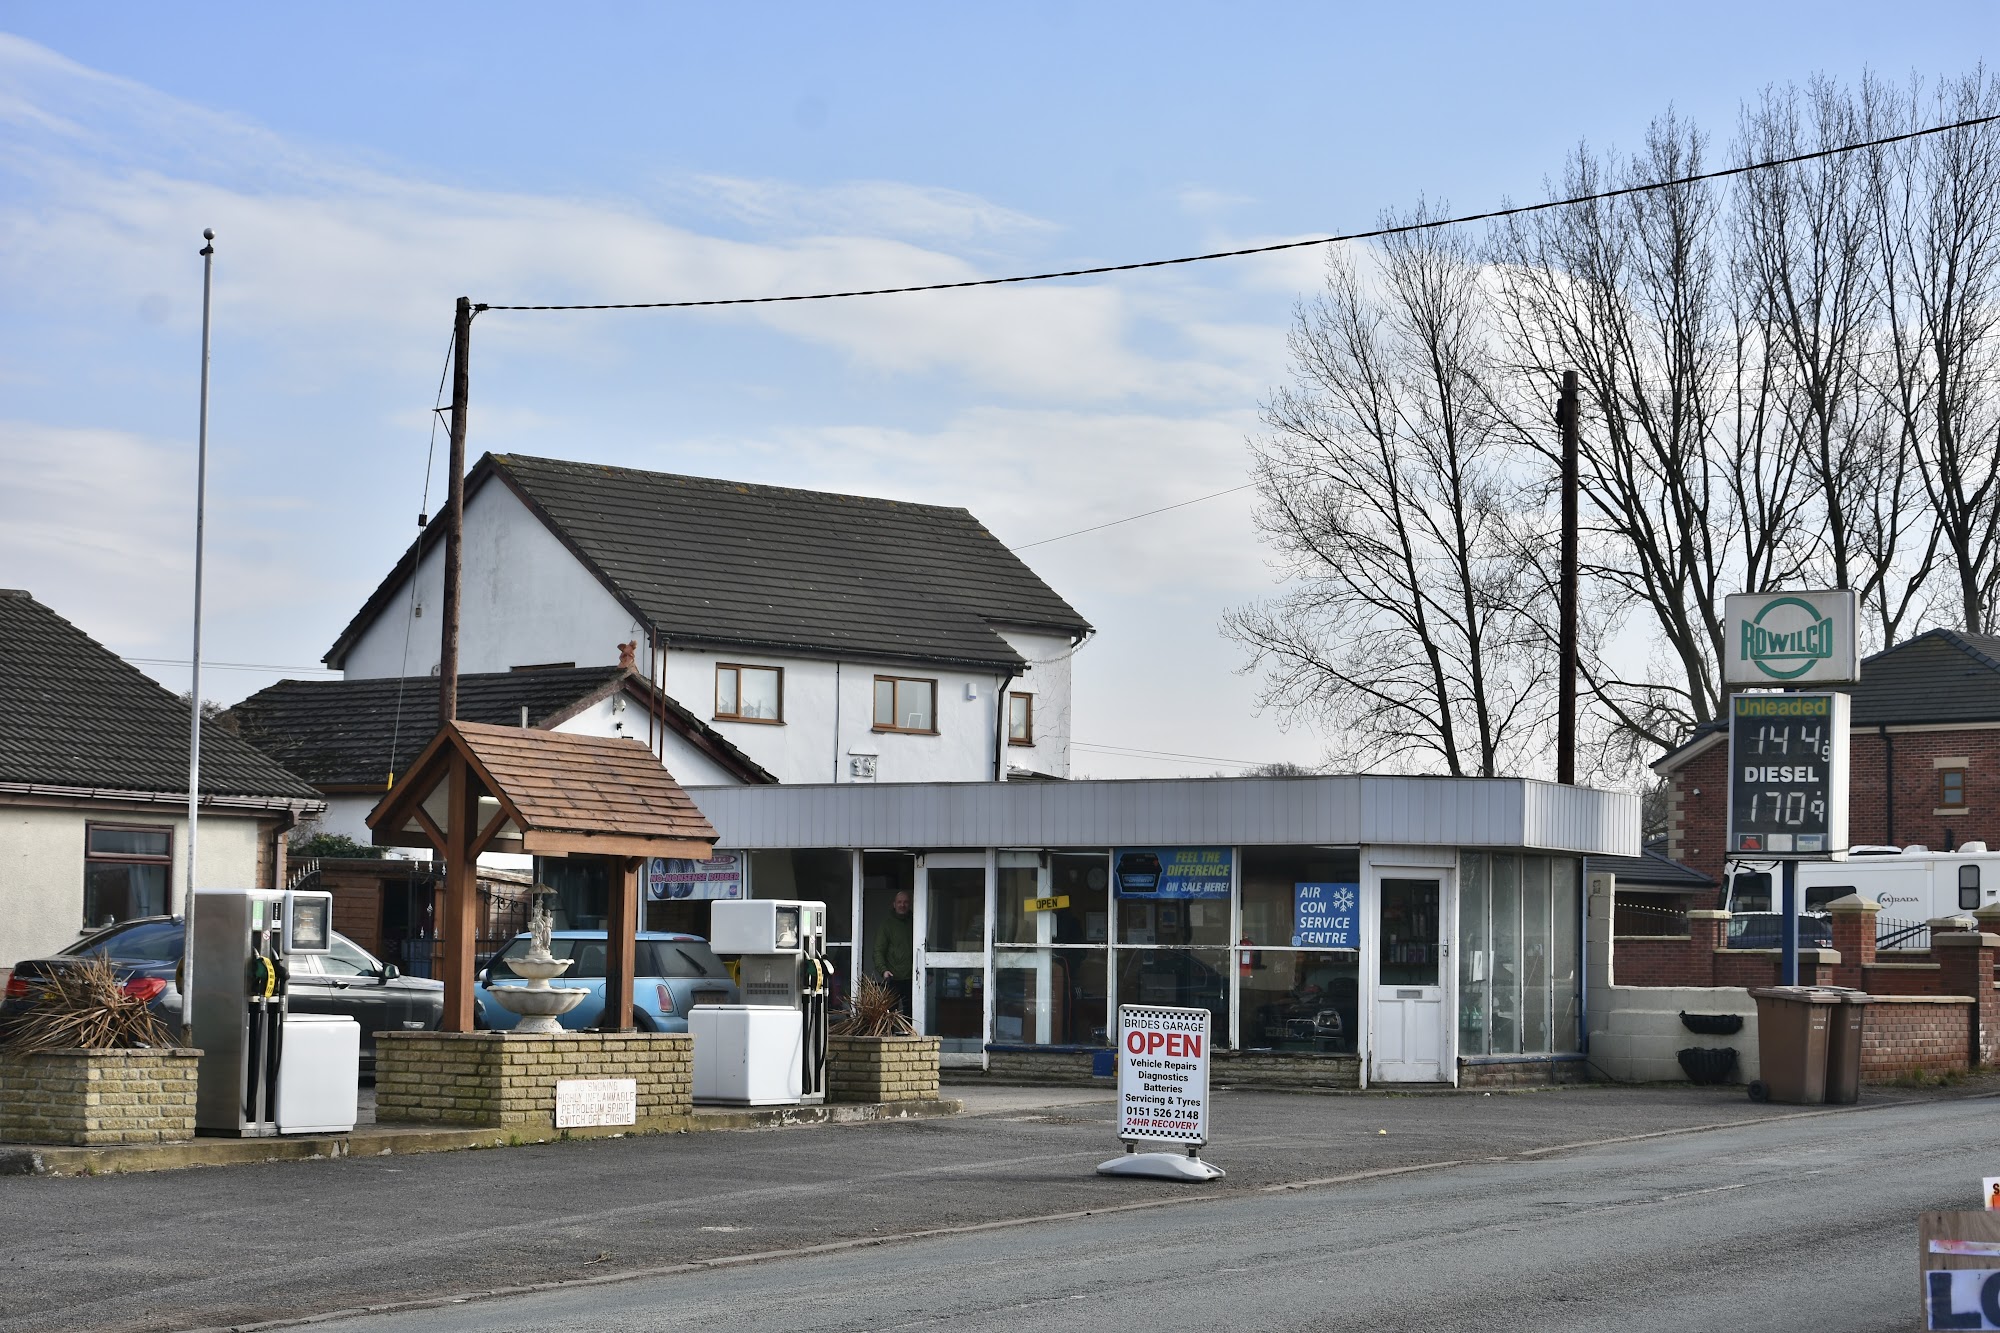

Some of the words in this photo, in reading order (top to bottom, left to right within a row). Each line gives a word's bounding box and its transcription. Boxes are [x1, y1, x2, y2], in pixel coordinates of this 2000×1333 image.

[1741, 617, 1832, 660] ROWILCO
[1735, 698, 1827, 716] Unleaded
[1744, 766, 1819, 782] DIESEL
[1175, 851, 1198, 863] FEEL
[1201, 851, 1221, 863] THE
[1166, 864, 1230, 877] DIFFERENCE
[650, 873, 707, 883] NO-NONSENSE
[708, 872, 740, 882] RUBBER
[1166, 882, 1178, 892] ON
[1181, 882, 1202, 892] SALE
[1204, 882, 1229, 892] HERE!
[1300, 886, 1321, 898] AIR
[1036, 899, 1058, 909] OPEN
[1300, 902, 1327, 913] CON
[1300, 917, 1351, 929] SERVICE
[1301, 932, 1347, 944] CENTRE
[1124, 1018, 1160, 1030] BRIDES
[1162, 1020, 1204, 1032] GARAGE
[1127, 1030, 1202, 1058] OPEN
[1130, 1058, 1162, 1068] Vehicle
[1164, 1060, 1197, 1071] Repairs
[1138, 1070, 1189, 1082] Diagnostics
[1143, 1083, 1183, 1093] Batteries
[558, 1092, 582, 1104] HIGHLY
[585, 1091, 635, 1103] INFLAMMABLE
[1125, 1093, 1165, 1106] Servicing
[1167, 1096, 1174, 1105] &
[1176, 1096, 1201, 1107] Tyres
[561, 1103, 605, 1114] PETROLEUM
[607, 1102, 630, 1113] SPIRIT
[1126, 1106, 1150, 1116] 0151
[1153, 1108, 1172, 1118] 526
[1174, 1109, 1199, 1120] 2148
[560, 1114, 585, 1126] SWITCH
[588, 1114, 602, 1125] OFF
[605, 1112, 631, 1124] ENGINE
[1126, 1117, 1149, 1127] 24HR
[1151, 1119, 1199, 1130] RECOVERY
